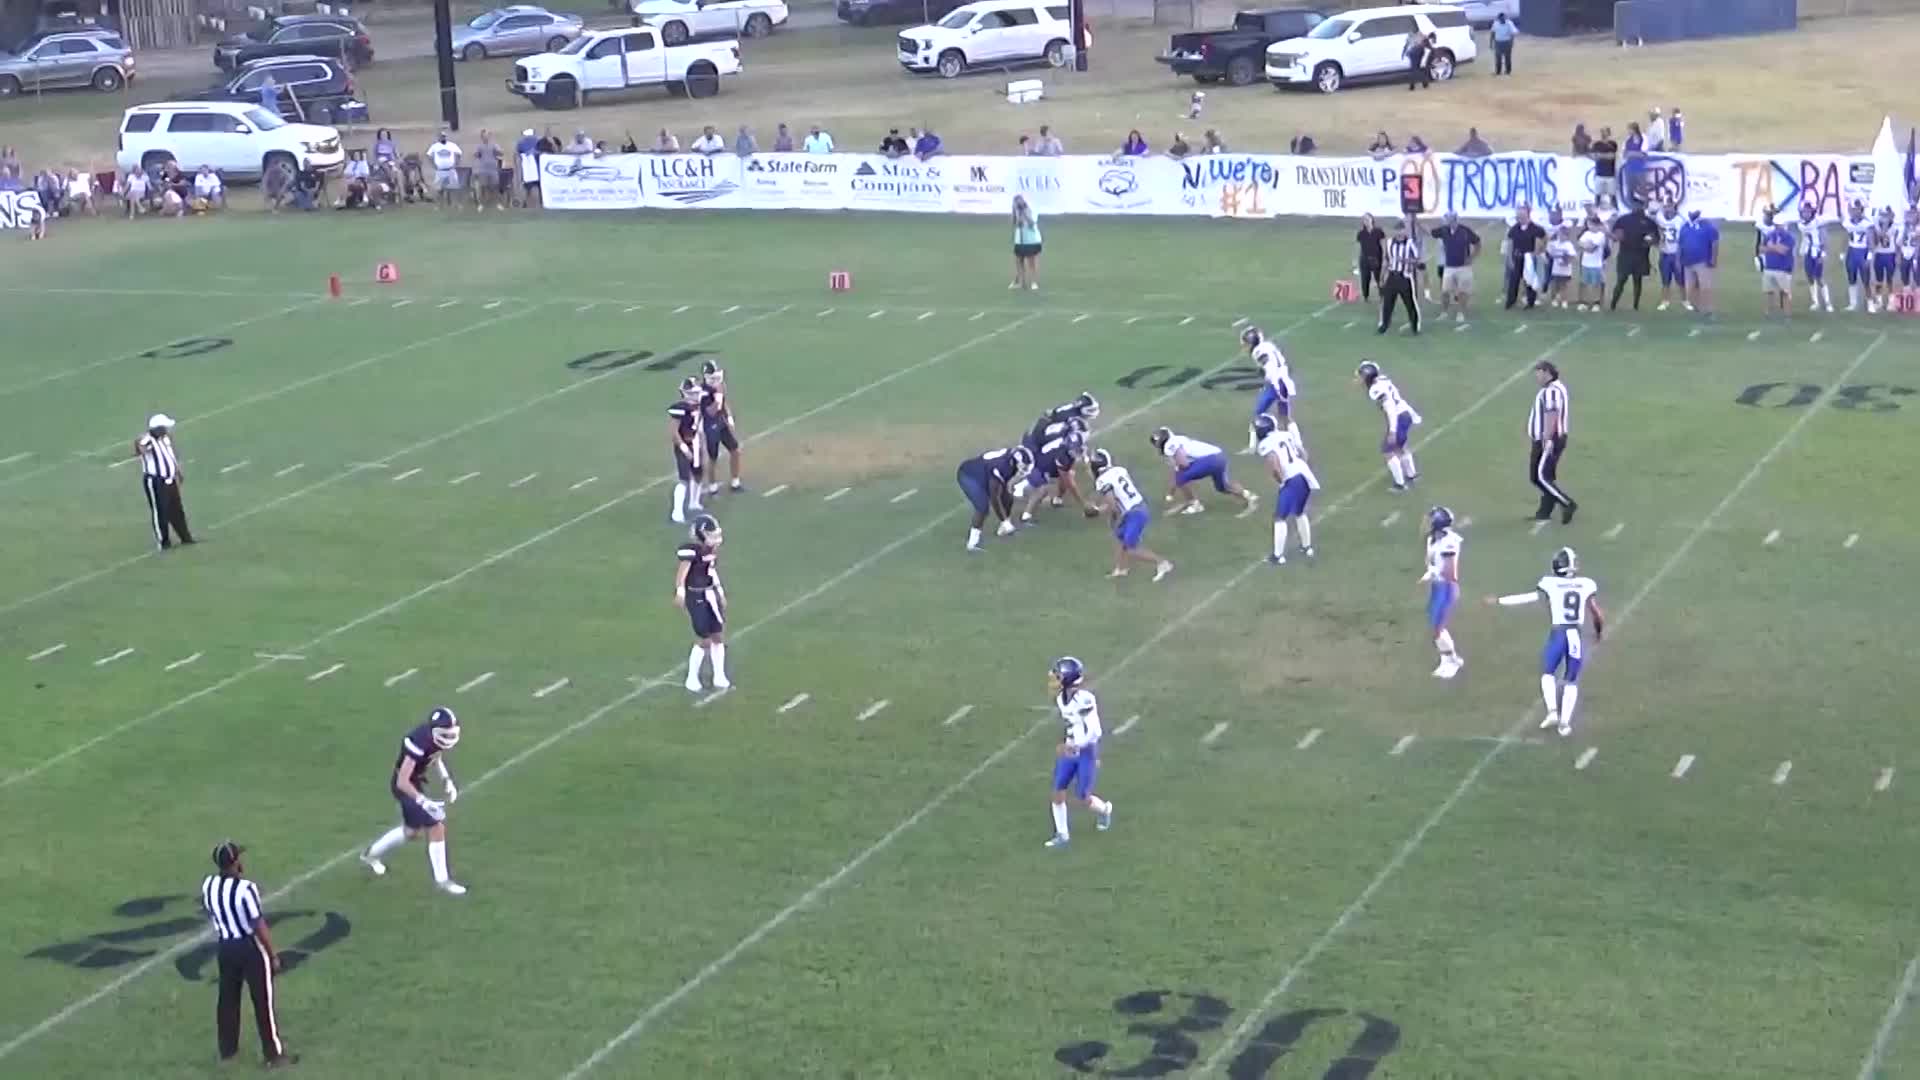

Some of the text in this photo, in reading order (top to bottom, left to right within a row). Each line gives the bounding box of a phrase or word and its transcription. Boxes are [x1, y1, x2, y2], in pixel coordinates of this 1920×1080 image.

[850, 178, 943, 197] Company
[1296, 164, 1376, 186] TRANSYLVANIA
[1441, 157, 1557, 211] TROJANS
[1220, 182, 1267, 215] #1
[1323, 188, 1347, 208] TIRE
[1117, 475, 1137, 500] 2
[1562, 590, 1581, 622] 9
[1054, 989, 1400, 1080] 30
